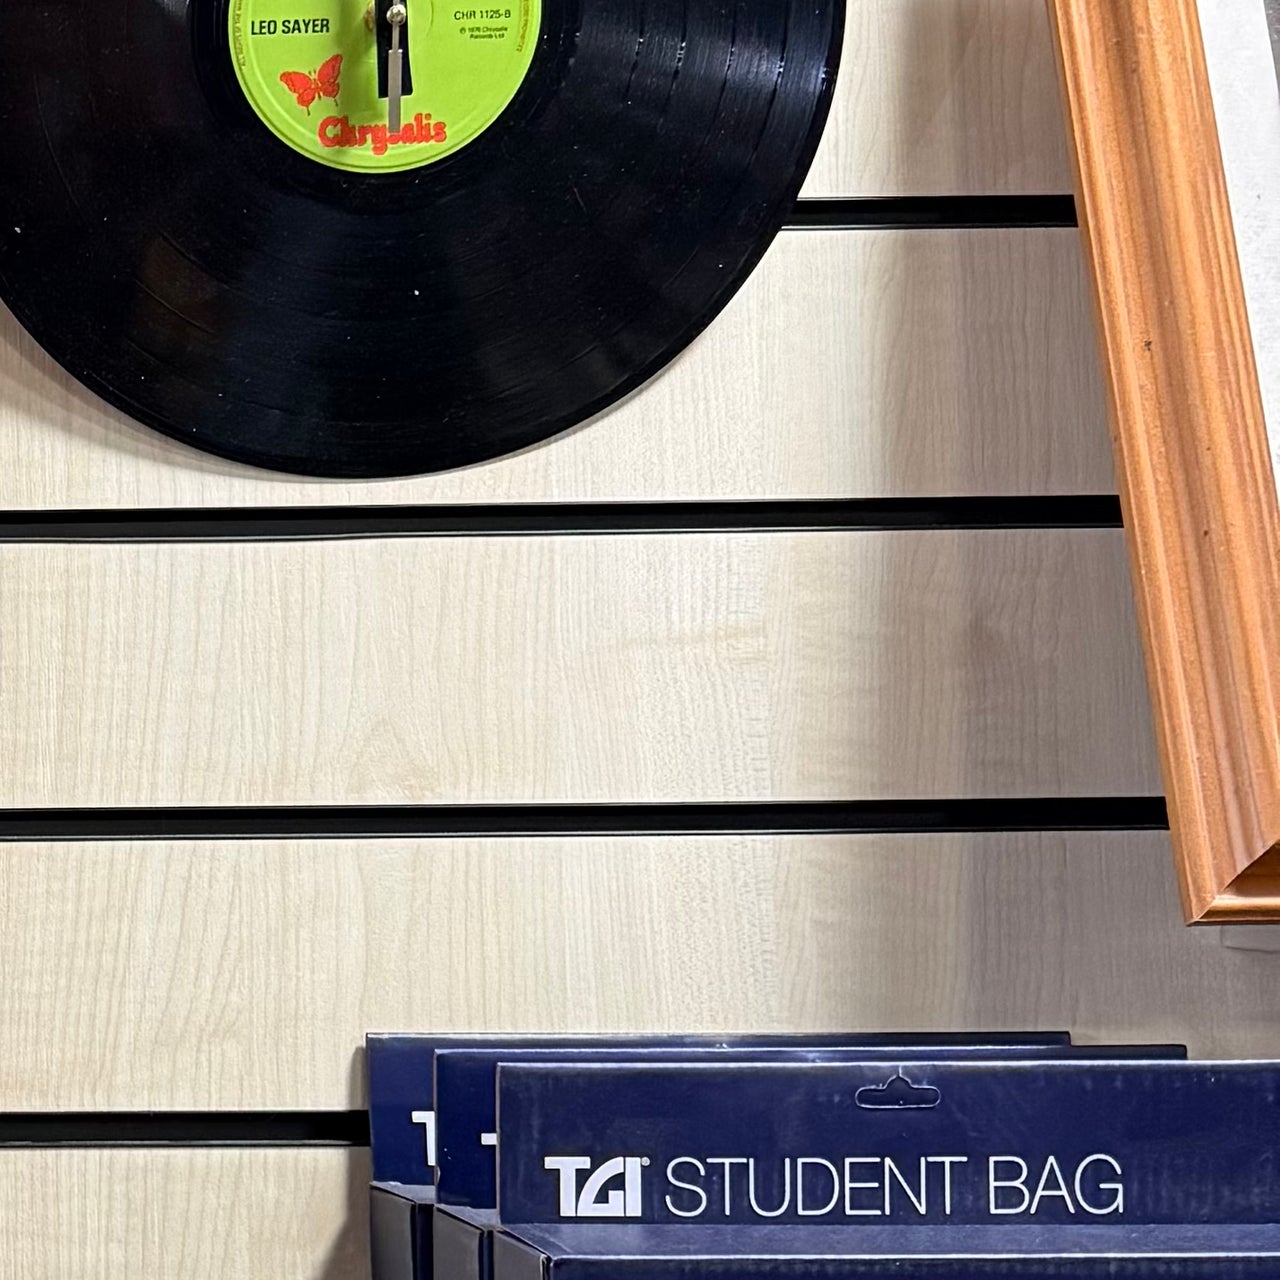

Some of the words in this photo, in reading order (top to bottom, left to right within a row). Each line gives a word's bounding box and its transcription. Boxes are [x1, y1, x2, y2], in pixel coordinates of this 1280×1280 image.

[251, 20, 277, 35] LEO
[281, 18, 330, 35] SAYER
[544, 1155, 643, 1218] TGI
[664, 1156, 968, 1218] STUDENT
[987, 1153, 1125, 1217] BAG
